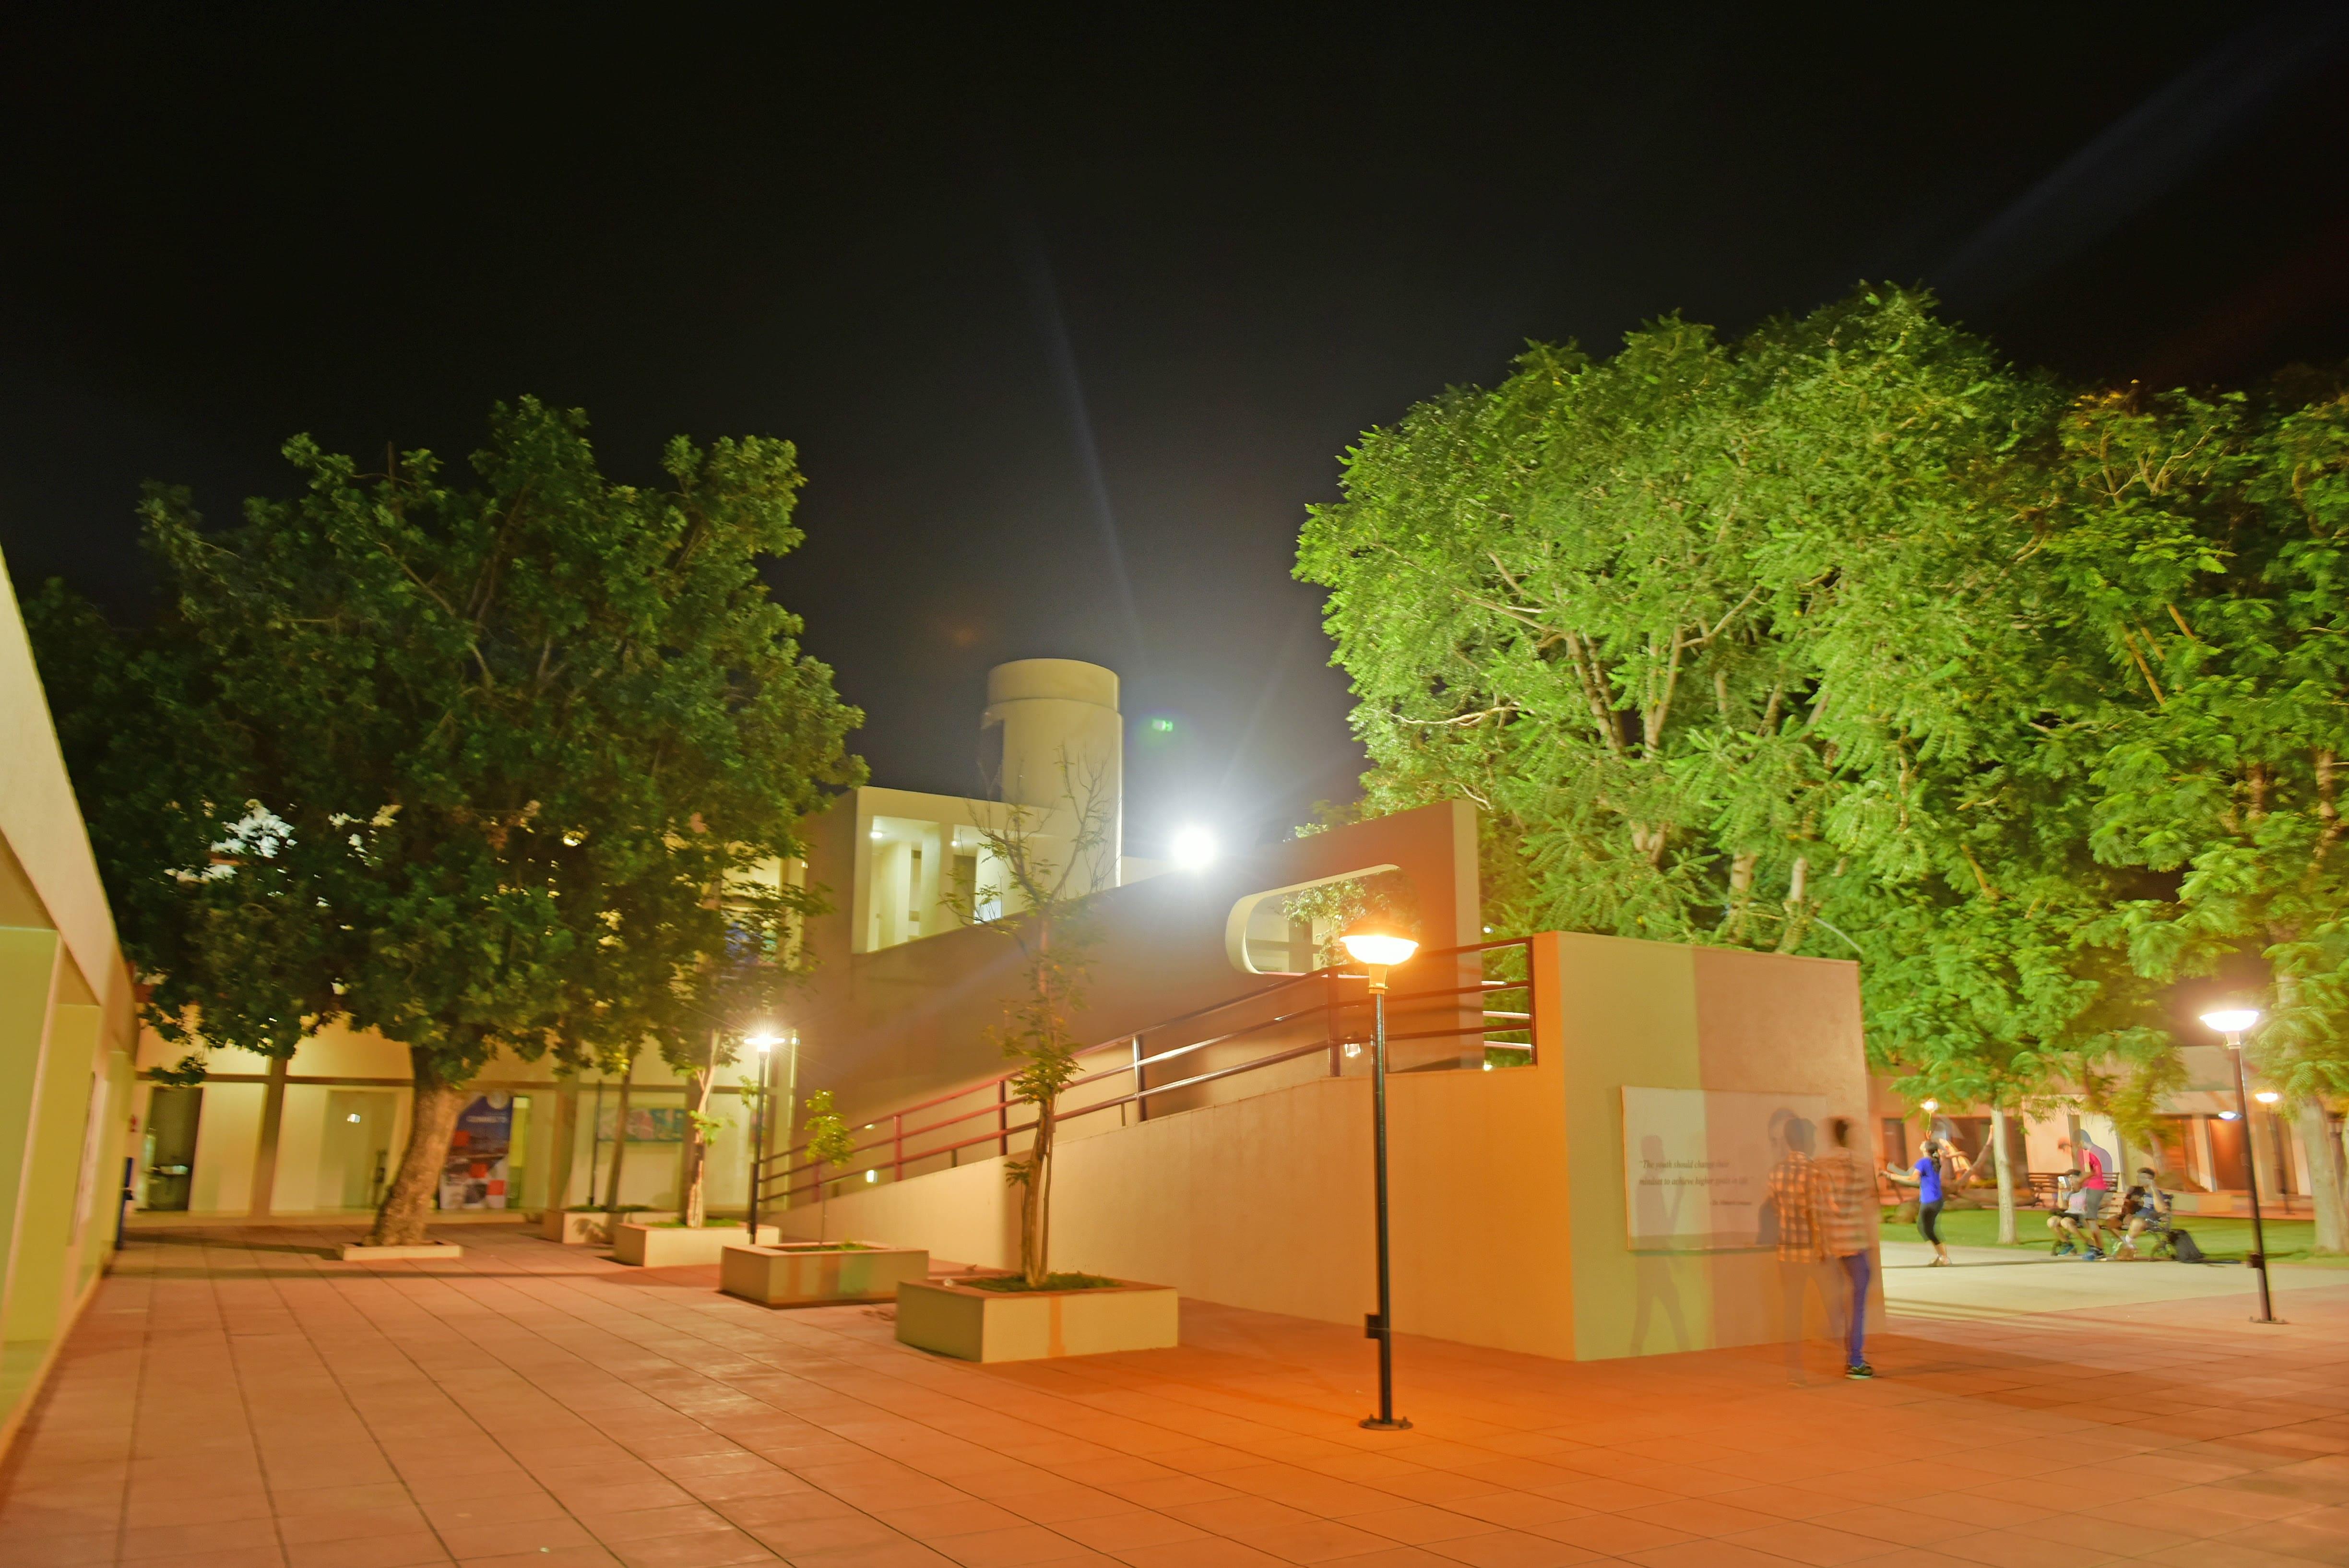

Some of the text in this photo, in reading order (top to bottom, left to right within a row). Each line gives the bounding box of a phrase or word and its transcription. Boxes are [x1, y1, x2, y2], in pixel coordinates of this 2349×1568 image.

[1673, 1159, 1693, 1168] should
[1639, 1176, 1662, 1185] mindset
[1672, 1176, 1694, 1185] achieve
[1695, 1175, 1714, 1186] higher
